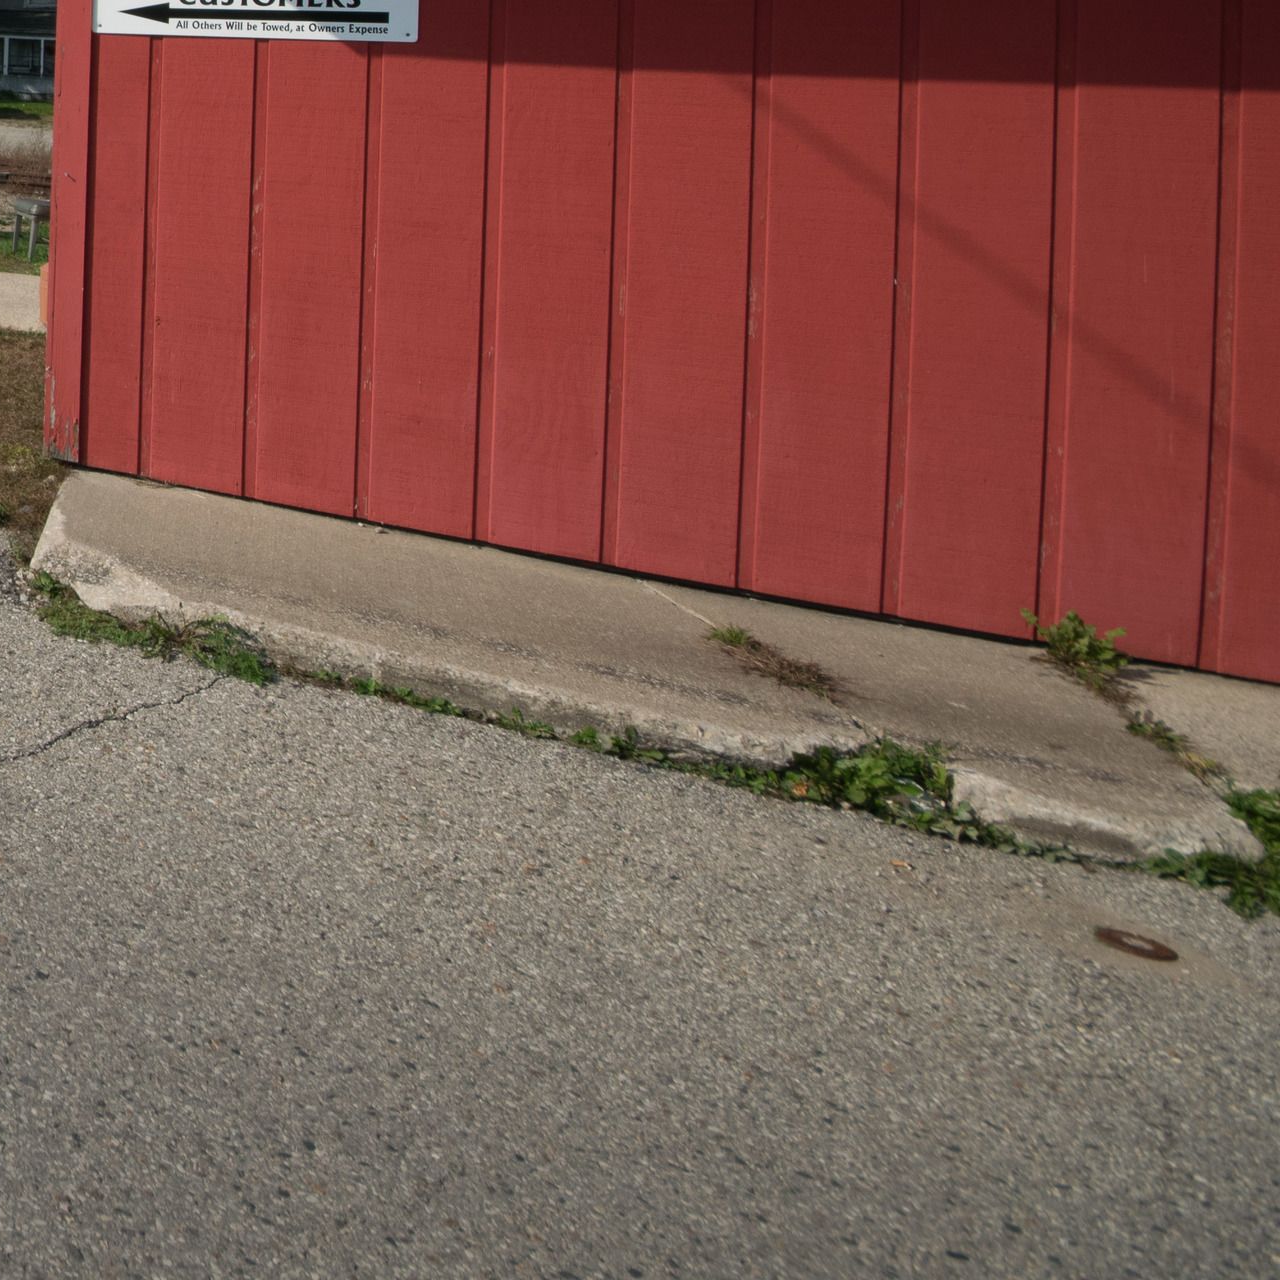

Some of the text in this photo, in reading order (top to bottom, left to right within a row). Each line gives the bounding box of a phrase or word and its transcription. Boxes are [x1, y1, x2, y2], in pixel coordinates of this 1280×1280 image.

[176, 20, 389, 36] All Others Will be Towed, at Owners Expense
